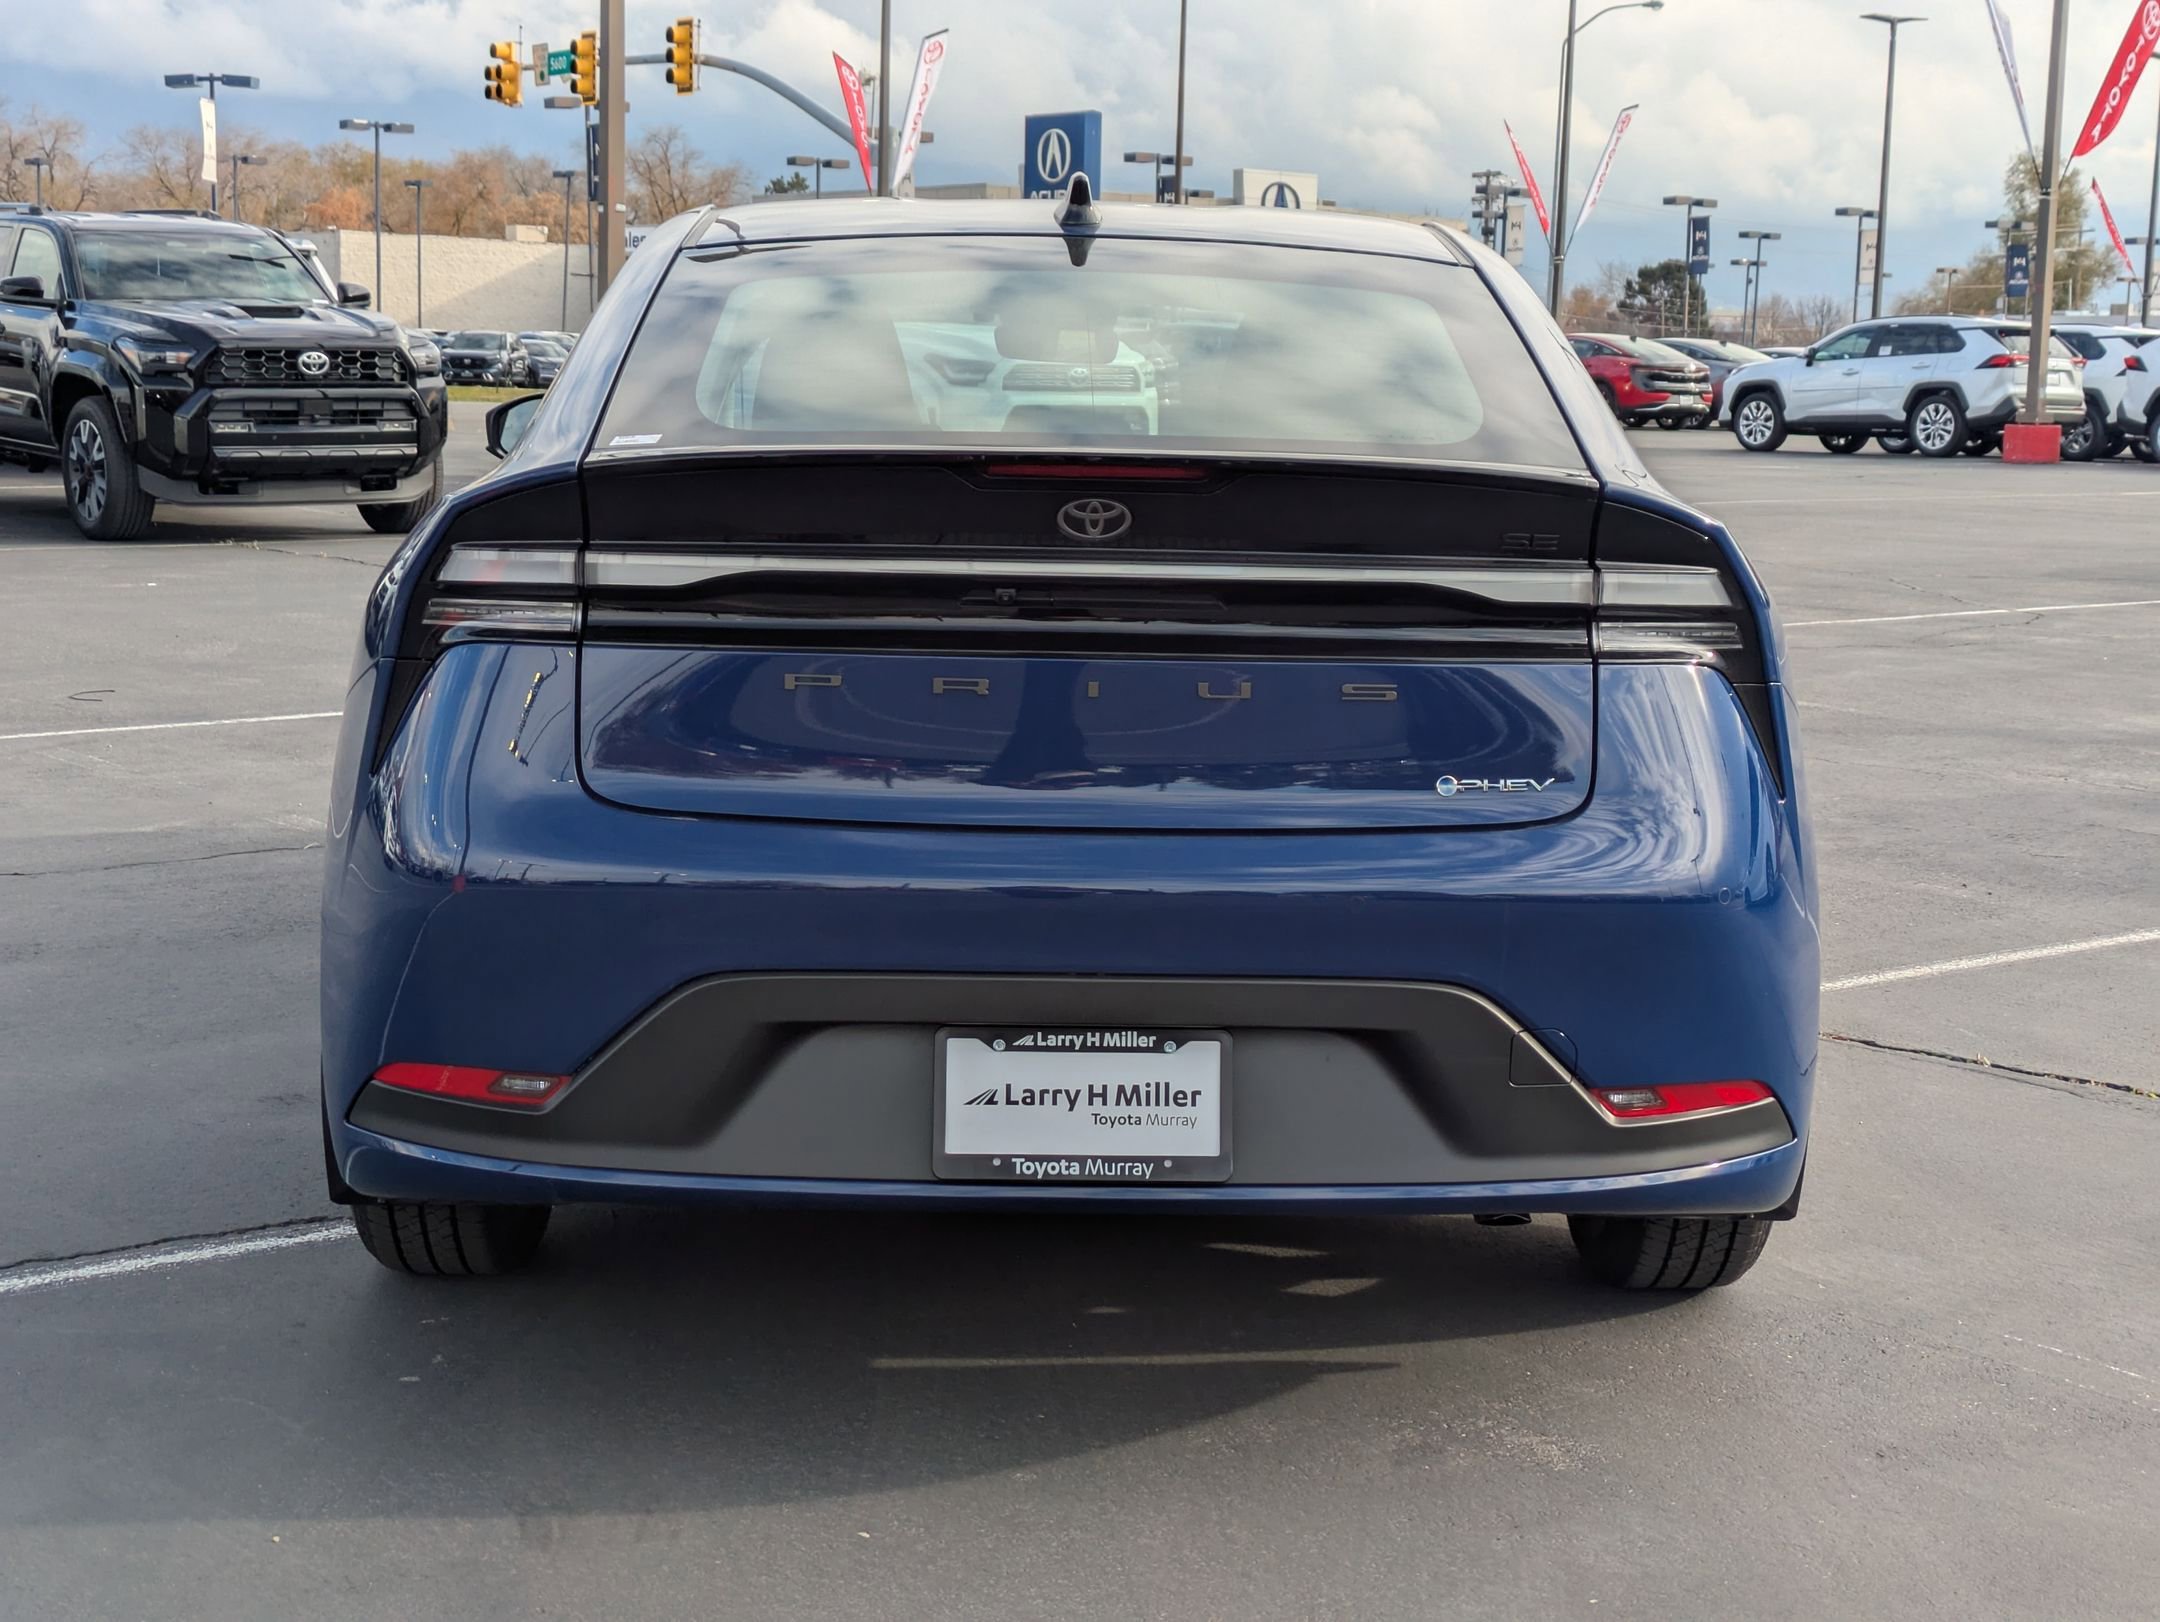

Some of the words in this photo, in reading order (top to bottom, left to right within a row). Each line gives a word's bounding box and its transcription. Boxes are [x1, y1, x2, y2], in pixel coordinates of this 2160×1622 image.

[2091, 33, 2145, 143] TOYOTA
[1501, 532, 1560, 551] SE
[784, 673, 1398, 701] PRIUS
[1457, 777, 1556, 792] PHEV
[1037, 1032, 1084, 1050] Larry
[1087, 1032, 1100, 1047] H
[1104, 1032, 1157, 1048] Miller
[1005, 1083, 1081, 1112] Larry
[1088, 1084, 1108, 1107] H
[1115, 1082, 1202, 1107] Miller
[1091, 1113, 1142, 1129] Toyota
[1146, 1114, 1198, 1129] Murray
[1011, 1157, 1080, 1179] Toyota
[1085, 1158, 1154, 1179] Murray
